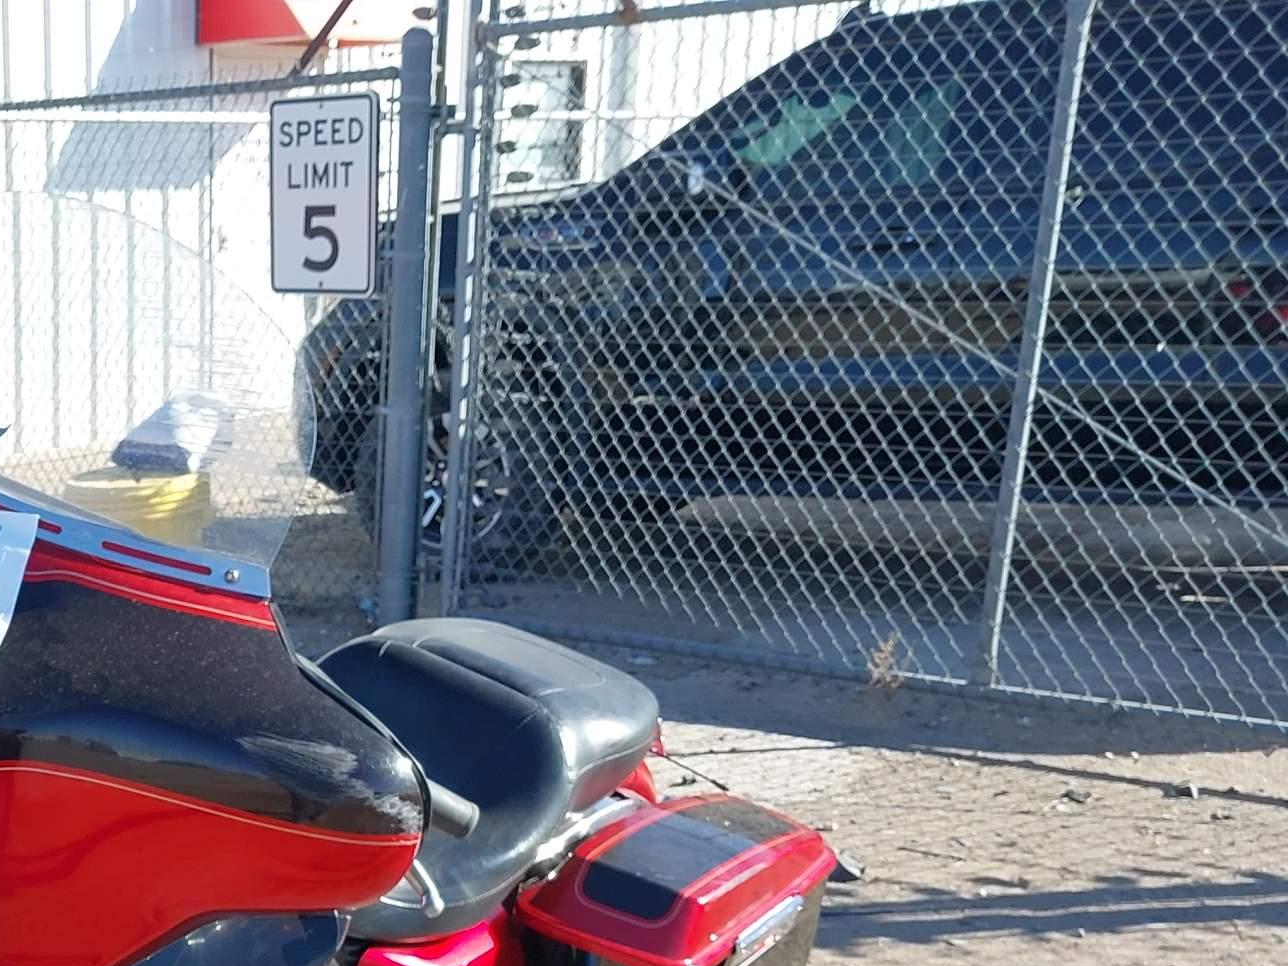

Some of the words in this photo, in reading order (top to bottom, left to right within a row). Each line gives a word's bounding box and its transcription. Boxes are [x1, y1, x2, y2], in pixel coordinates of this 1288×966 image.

[280, 117, 364, 147] SPEED
[288, 161, 353, 189] LIMIT
[302, 205, 339, 272] 5
